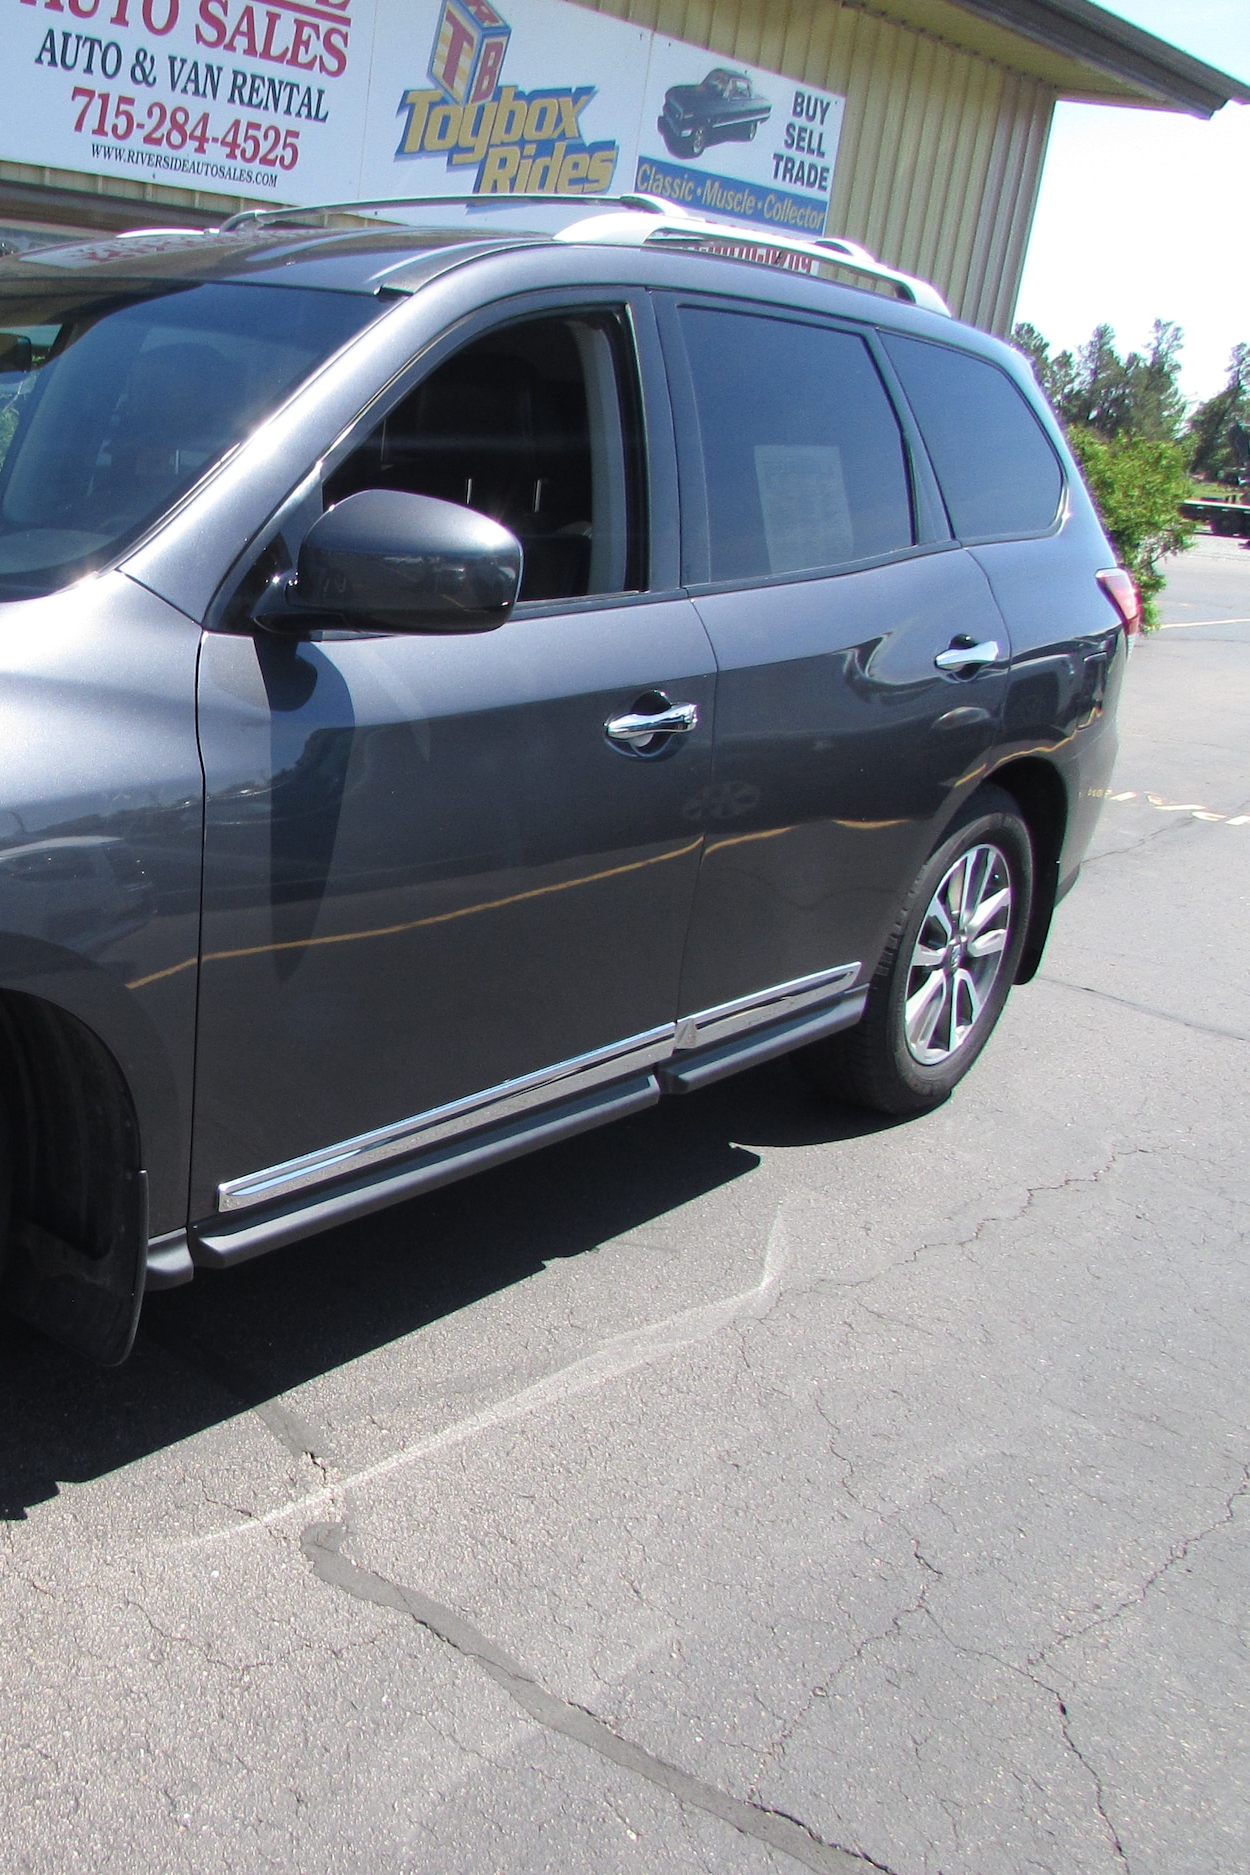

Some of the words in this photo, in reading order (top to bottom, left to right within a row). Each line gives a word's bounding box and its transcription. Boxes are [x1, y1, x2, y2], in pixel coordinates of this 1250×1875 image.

[195, 0, 350, 78] SALES
[34, 28, 123, 80] AUTO
[130, 47, 157, 88] &
[167, 54, 224, 102] VAN
[228, 70, 330, 124] RENTAL
[70, 86, 302, 173] 715-284-4525
[402, 86, 589, 166] Toybox
[792, 91, 831, 124] BUY
[90, 143, 278, 188] WWW.RIVERSIDEAUTOSALES.COM
[784, 121, 826, 158] SELL
[479, 144, 617, 199] Rides
[638, 164, 694, 201] Classic
[703, 181, 755, 215] Muscle
[764, 195, 825, 229] Collector
[772, 153, 830, 192] TRADE
